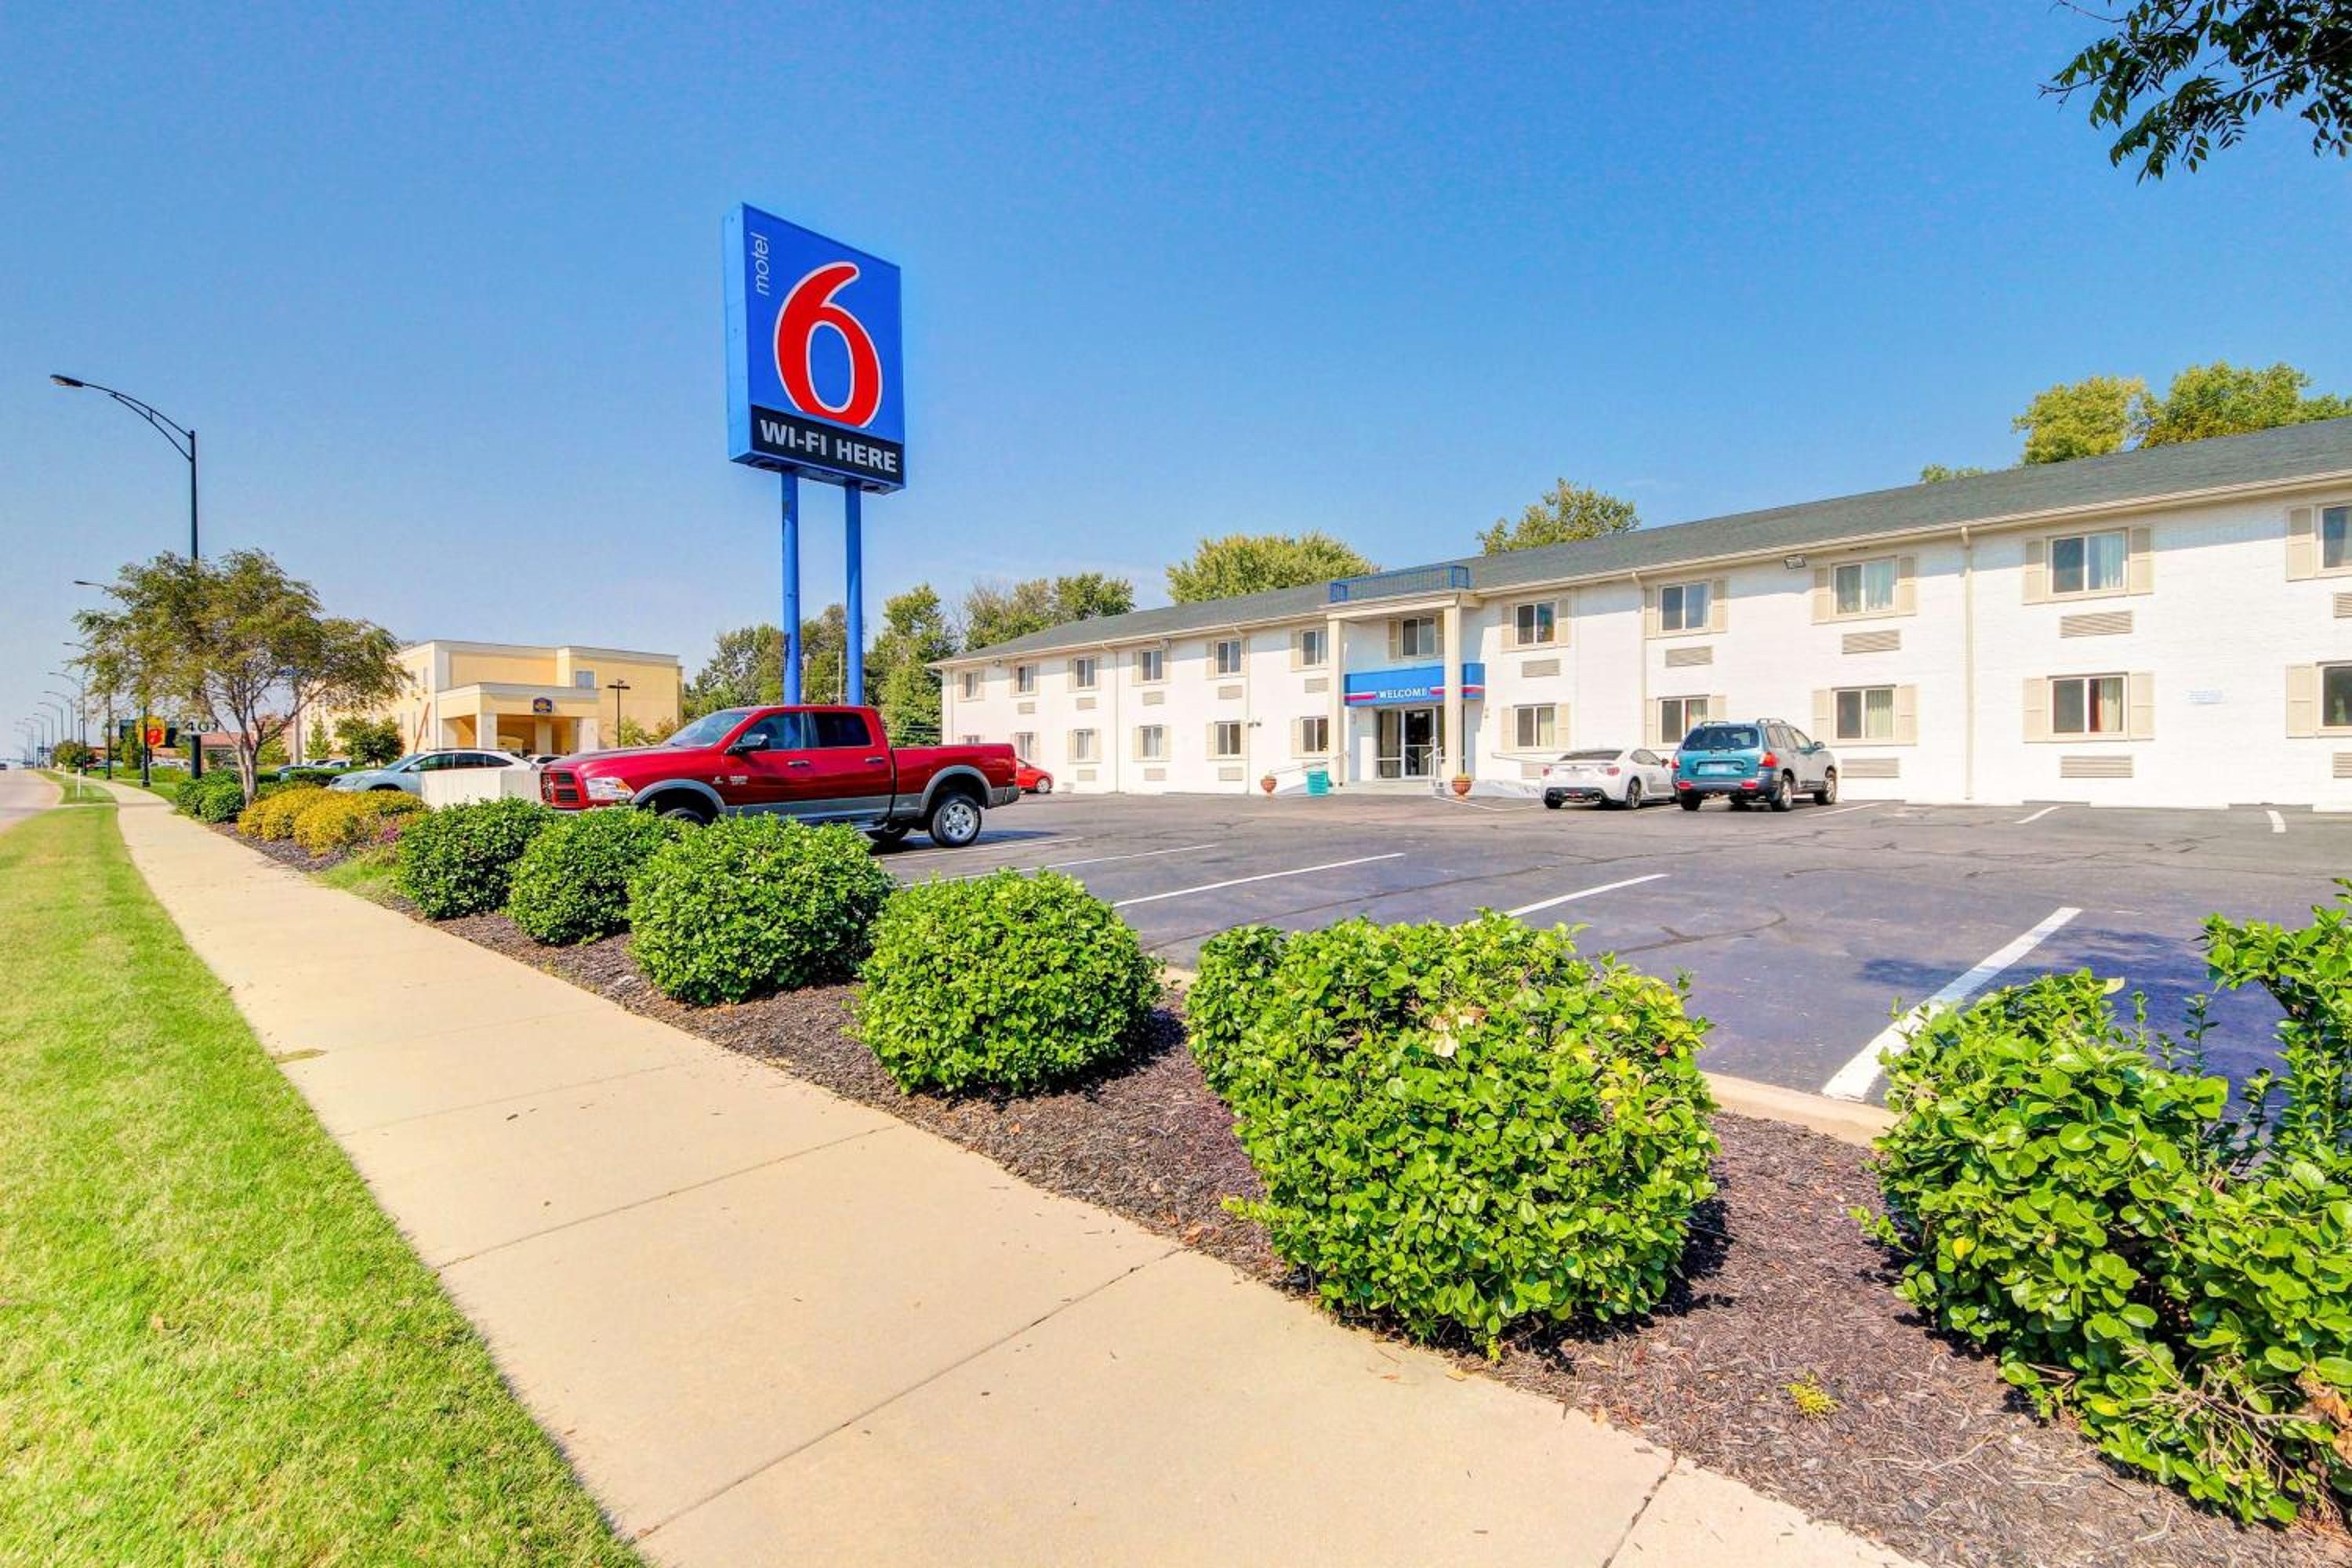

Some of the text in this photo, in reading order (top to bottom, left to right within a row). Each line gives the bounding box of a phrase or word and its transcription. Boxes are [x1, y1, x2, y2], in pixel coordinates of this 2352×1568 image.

[750, 232, 769, 296] motel
[774, 262, 882, 428] 6
[760, 419, 897, 473] WI-FI HERE
[1380, 688, 1427, 699] WELCOME
